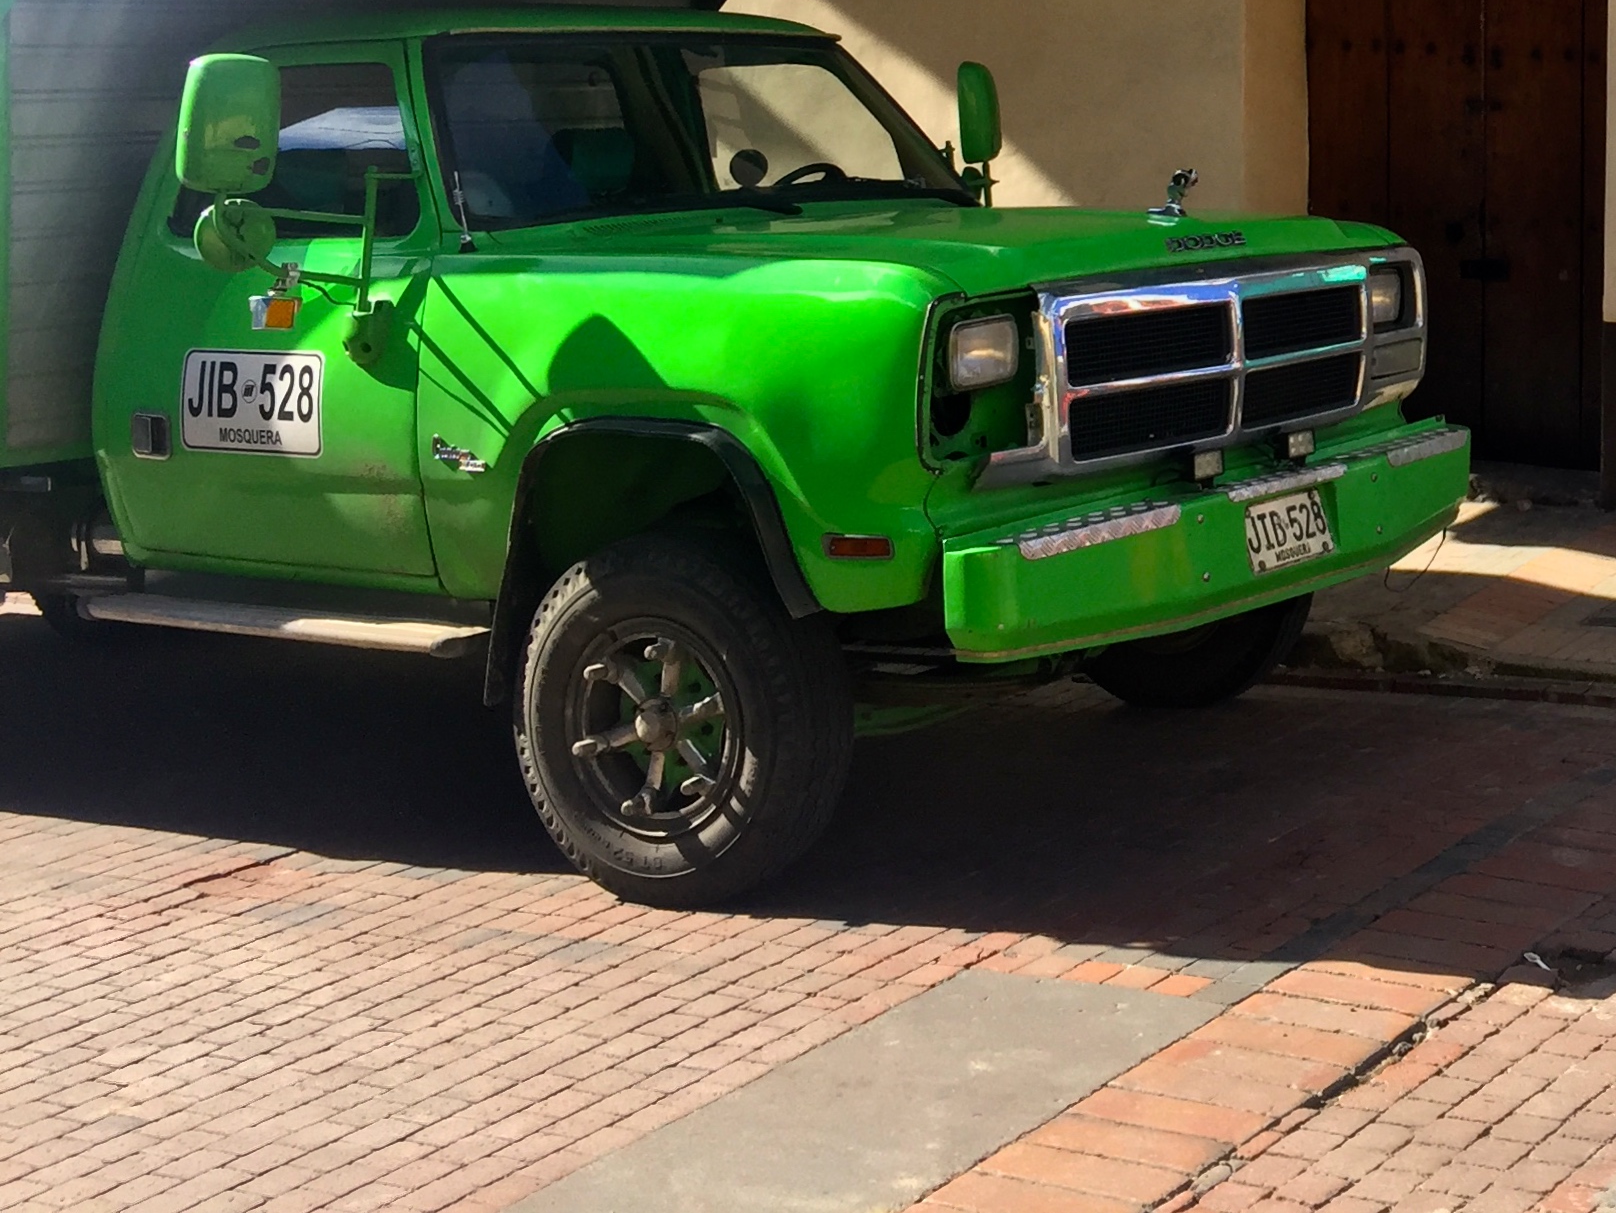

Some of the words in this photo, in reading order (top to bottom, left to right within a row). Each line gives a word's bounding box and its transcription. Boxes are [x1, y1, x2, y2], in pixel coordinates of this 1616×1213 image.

[187, 360, 239, 419] JIB
[258, 363, 314, 424] 528
[219, 427, 283, 446] MOSQUERA
[1247, 509, 1288, 555] JIB
[1285, 499, 1327, 543] 528
